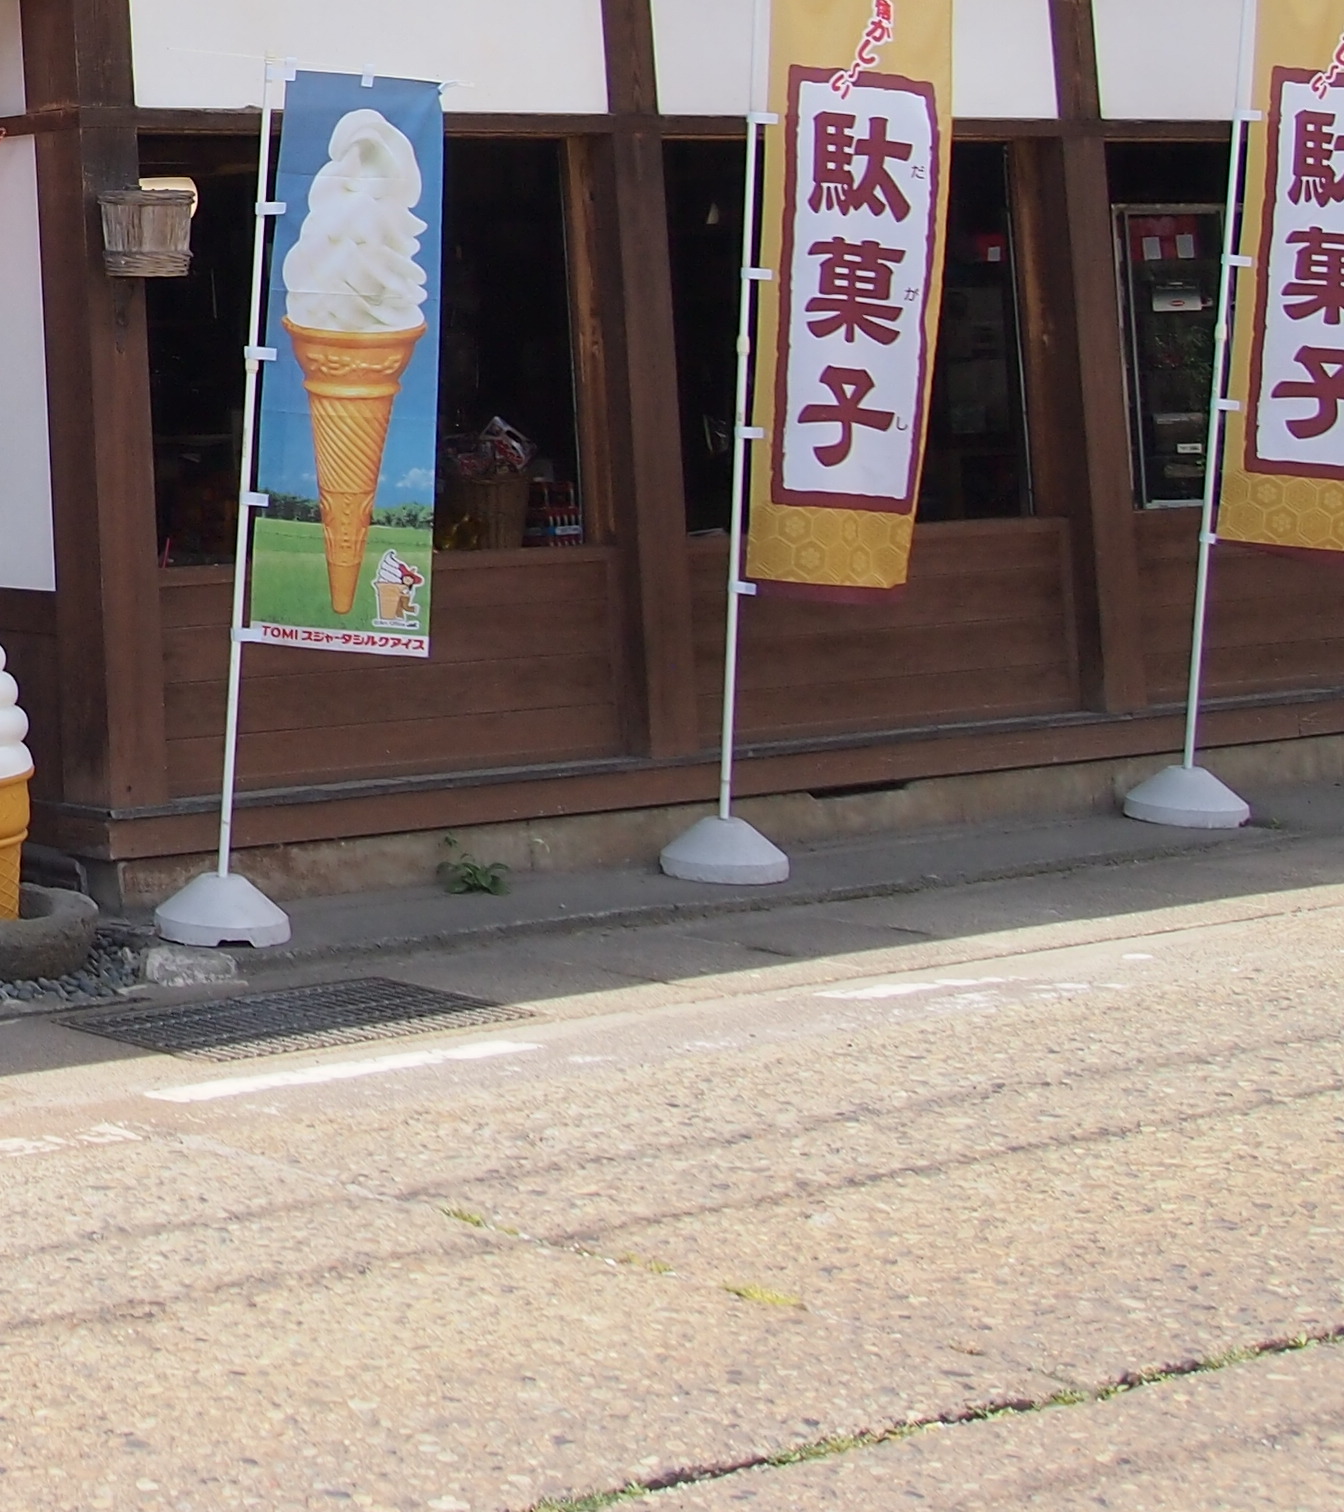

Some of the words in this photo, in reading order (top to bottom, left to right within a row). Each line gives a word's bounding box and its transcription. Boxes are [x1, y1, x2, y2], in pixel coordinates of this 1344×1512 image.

[798, 110, 914, 468] 駄菓子
[262, 625, 298, 641] TOMI
[302, 630, 425, 650] スジャータシルクアイス
